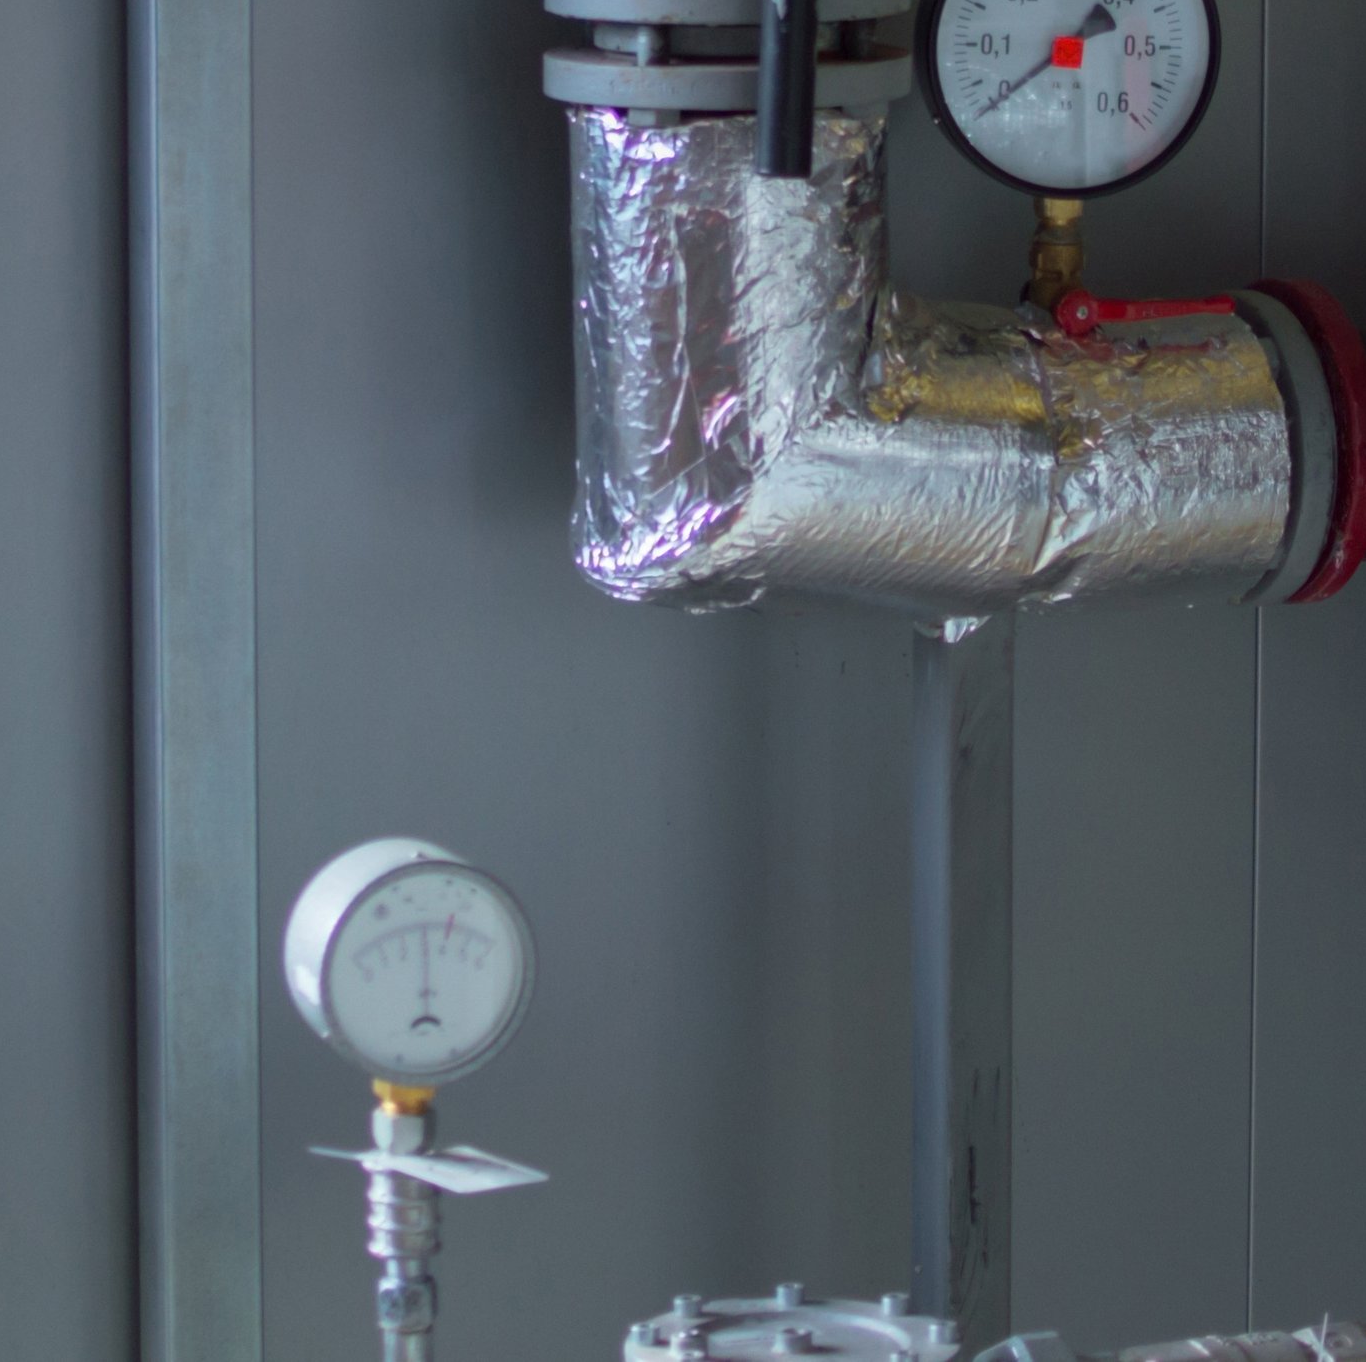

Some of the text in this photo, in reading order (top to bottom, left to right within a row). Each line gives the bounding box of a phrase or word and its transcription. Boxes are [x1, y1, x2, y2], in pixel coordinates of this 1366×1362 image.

[980, 34, 1010, 59] 0,1
[1124, 35, 1156, 60] 0,5
[1097, 92, 1129, 116] 0,6
